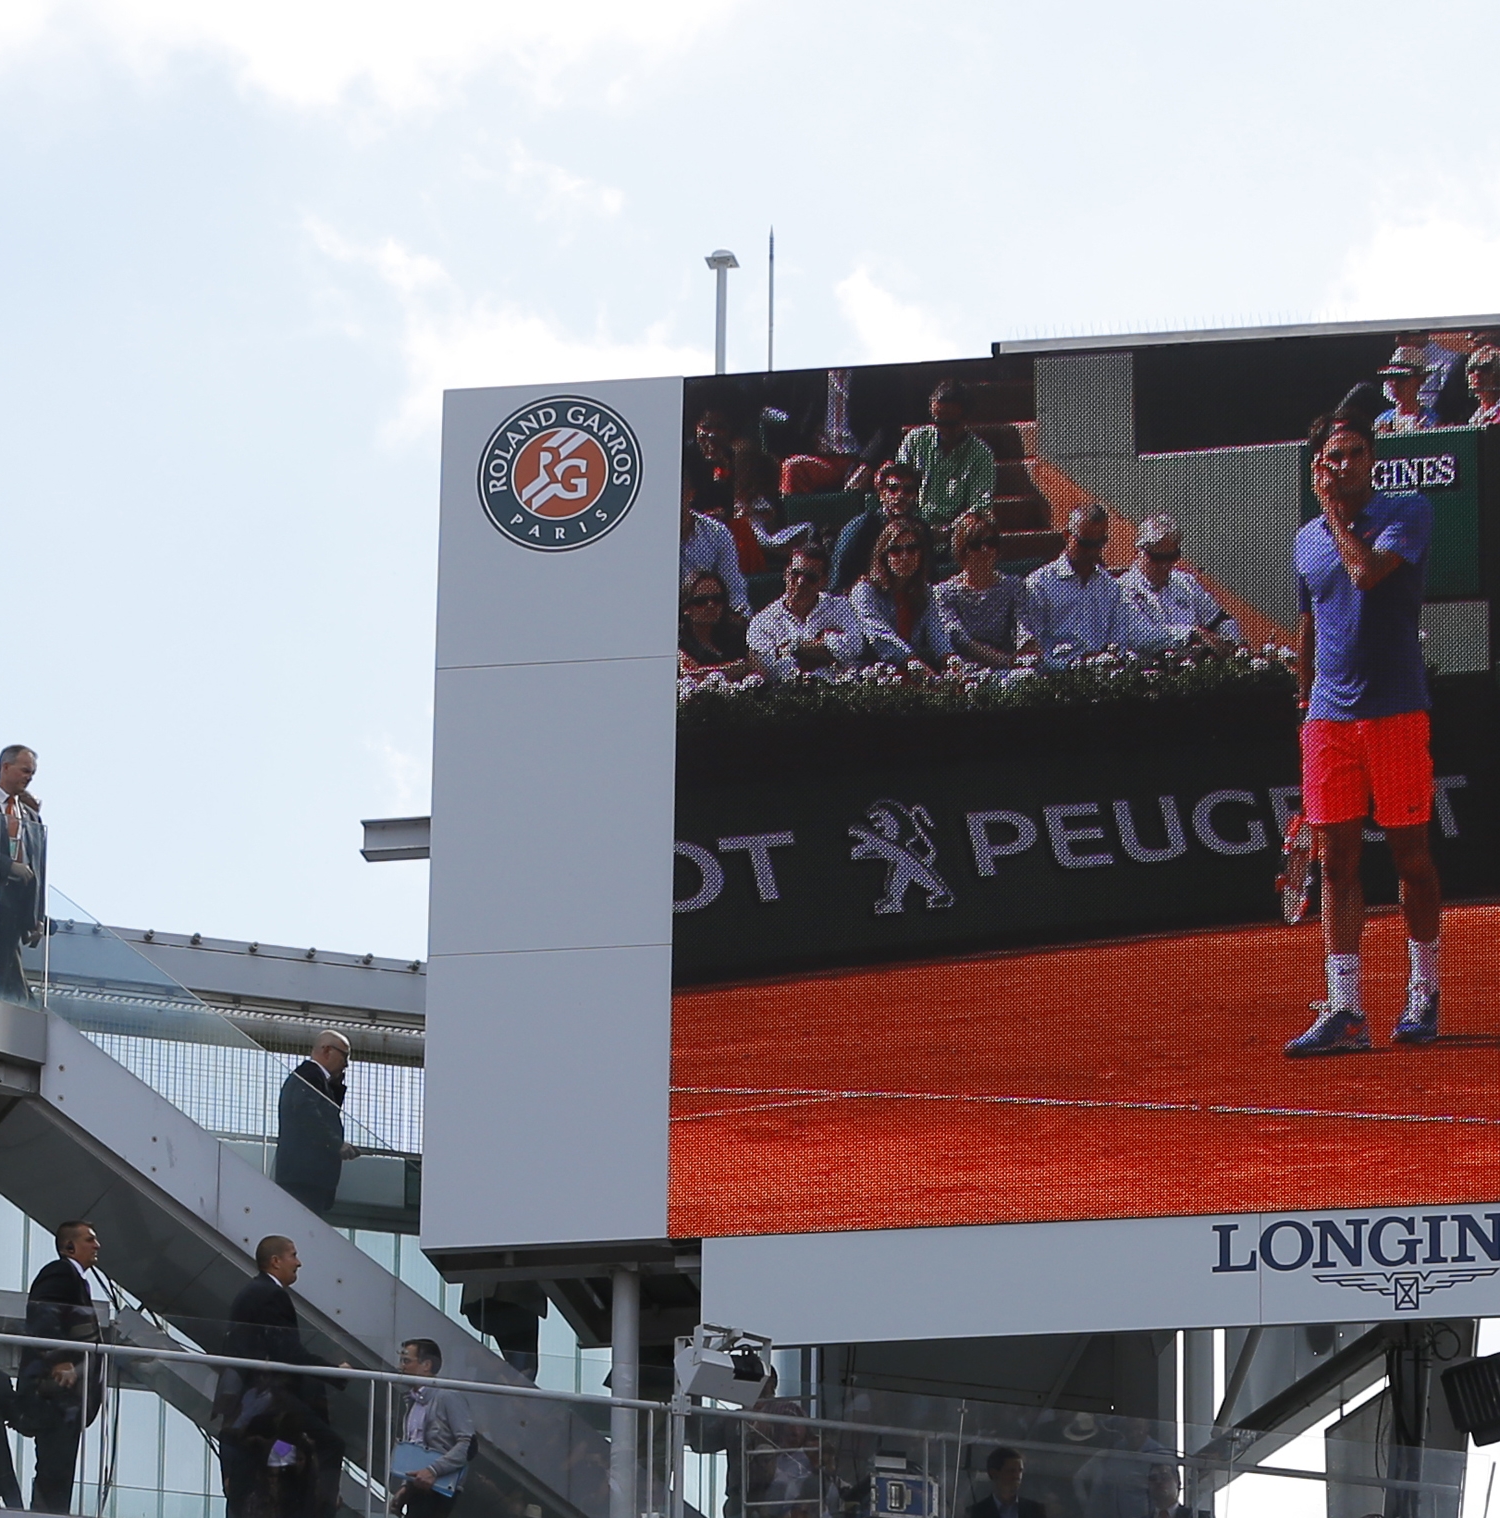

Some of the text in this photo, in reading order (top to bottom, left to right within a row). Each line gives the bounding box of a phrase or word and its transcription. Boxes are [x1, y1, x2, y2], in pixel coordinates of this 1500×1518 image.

[488, 406, 631, 494] ROLAND GARROS
[510, 509, 607, 540] PARIS
